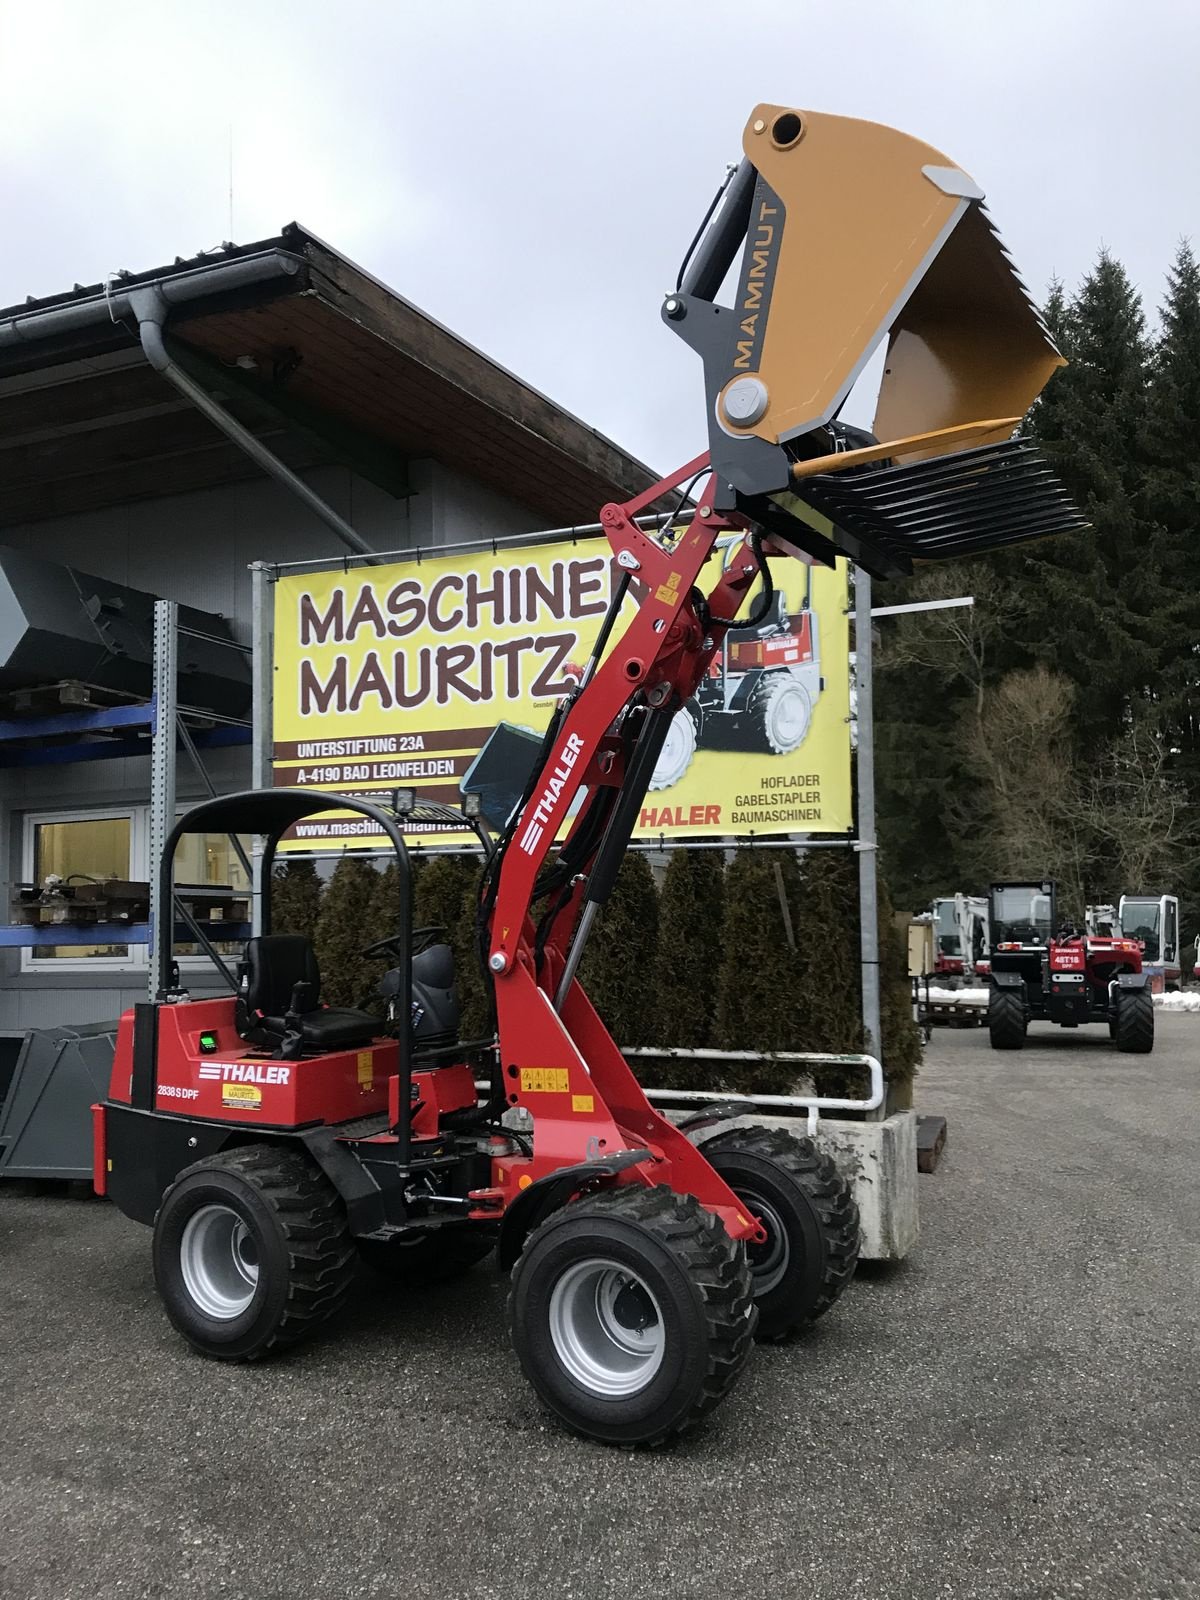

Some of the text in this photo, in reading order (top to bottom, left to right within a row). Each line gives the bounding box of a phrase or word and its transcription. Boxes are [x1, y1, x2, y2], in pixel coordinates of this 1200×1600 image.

[733, 202, 777, 368] MAMMUT
[301, 633, 577, 715] MAURITZ
[297, 735, 425, 758] UNTERSTIFTUNG 23A
[297, 760, 455, 783] A-4190 BAD LEONFELDEN
[532, 732, 585, 824] THALER
[761, 774, 820, 789] HOFLADER
[735, 791, 821, 807] GABELSTAPLER
[639, 804, 722, 828] HALER
[731, 808, 821, 824] BAUMASCHINEN
[221, 1063, 290, 1085] THALER
[157, 1085, 176, 1098] 2838
[182, 1089, 199, 1100] DPF
